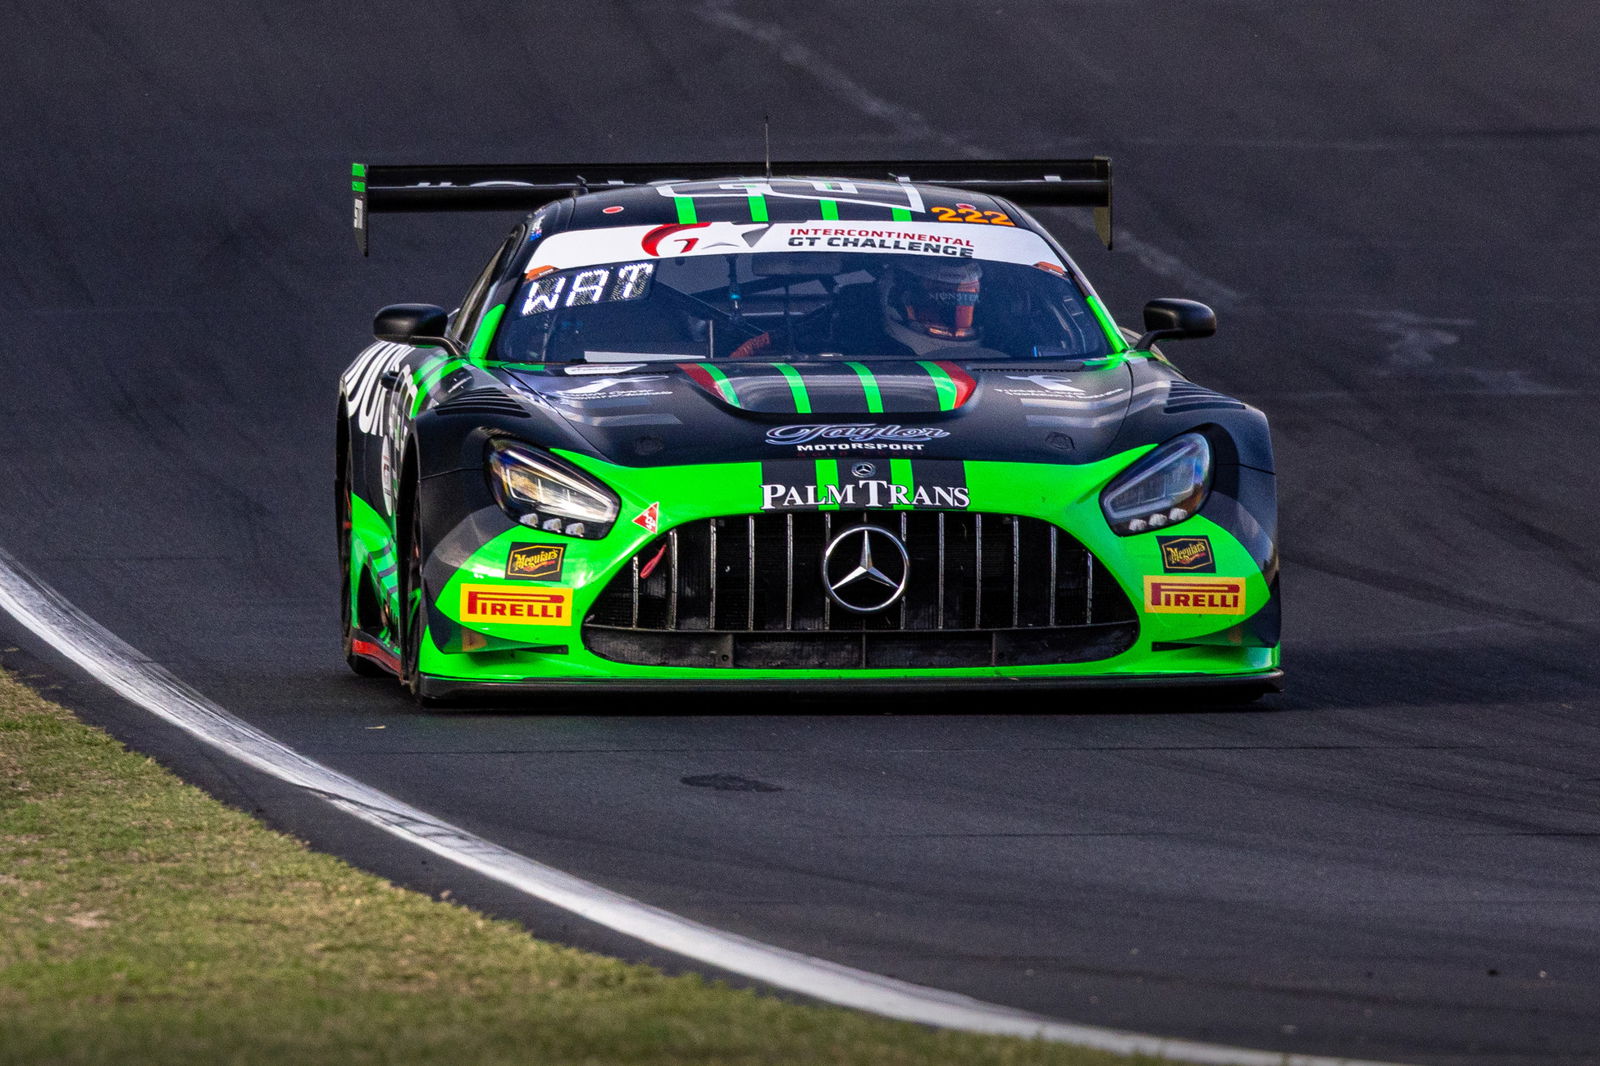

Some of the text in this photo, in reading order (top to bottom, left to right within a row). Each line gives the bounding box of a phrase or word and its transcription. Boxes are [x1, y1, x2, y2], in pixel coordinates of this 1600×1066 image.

[930, 206, 1016, 226] 222
[787, 237, 975, 259] GT CHALLENGE
[789, 228, 975, 248] INTERCONTINENTAL
[521, 262, 654, 316] WAT
[764, 423, 951, 446] Taylor
[796, 442, 925, 452] MOTORSPORT
[467, 590, 565, 619] PIRELLI
[1150, 582, 1241, 608] PIRELLI
